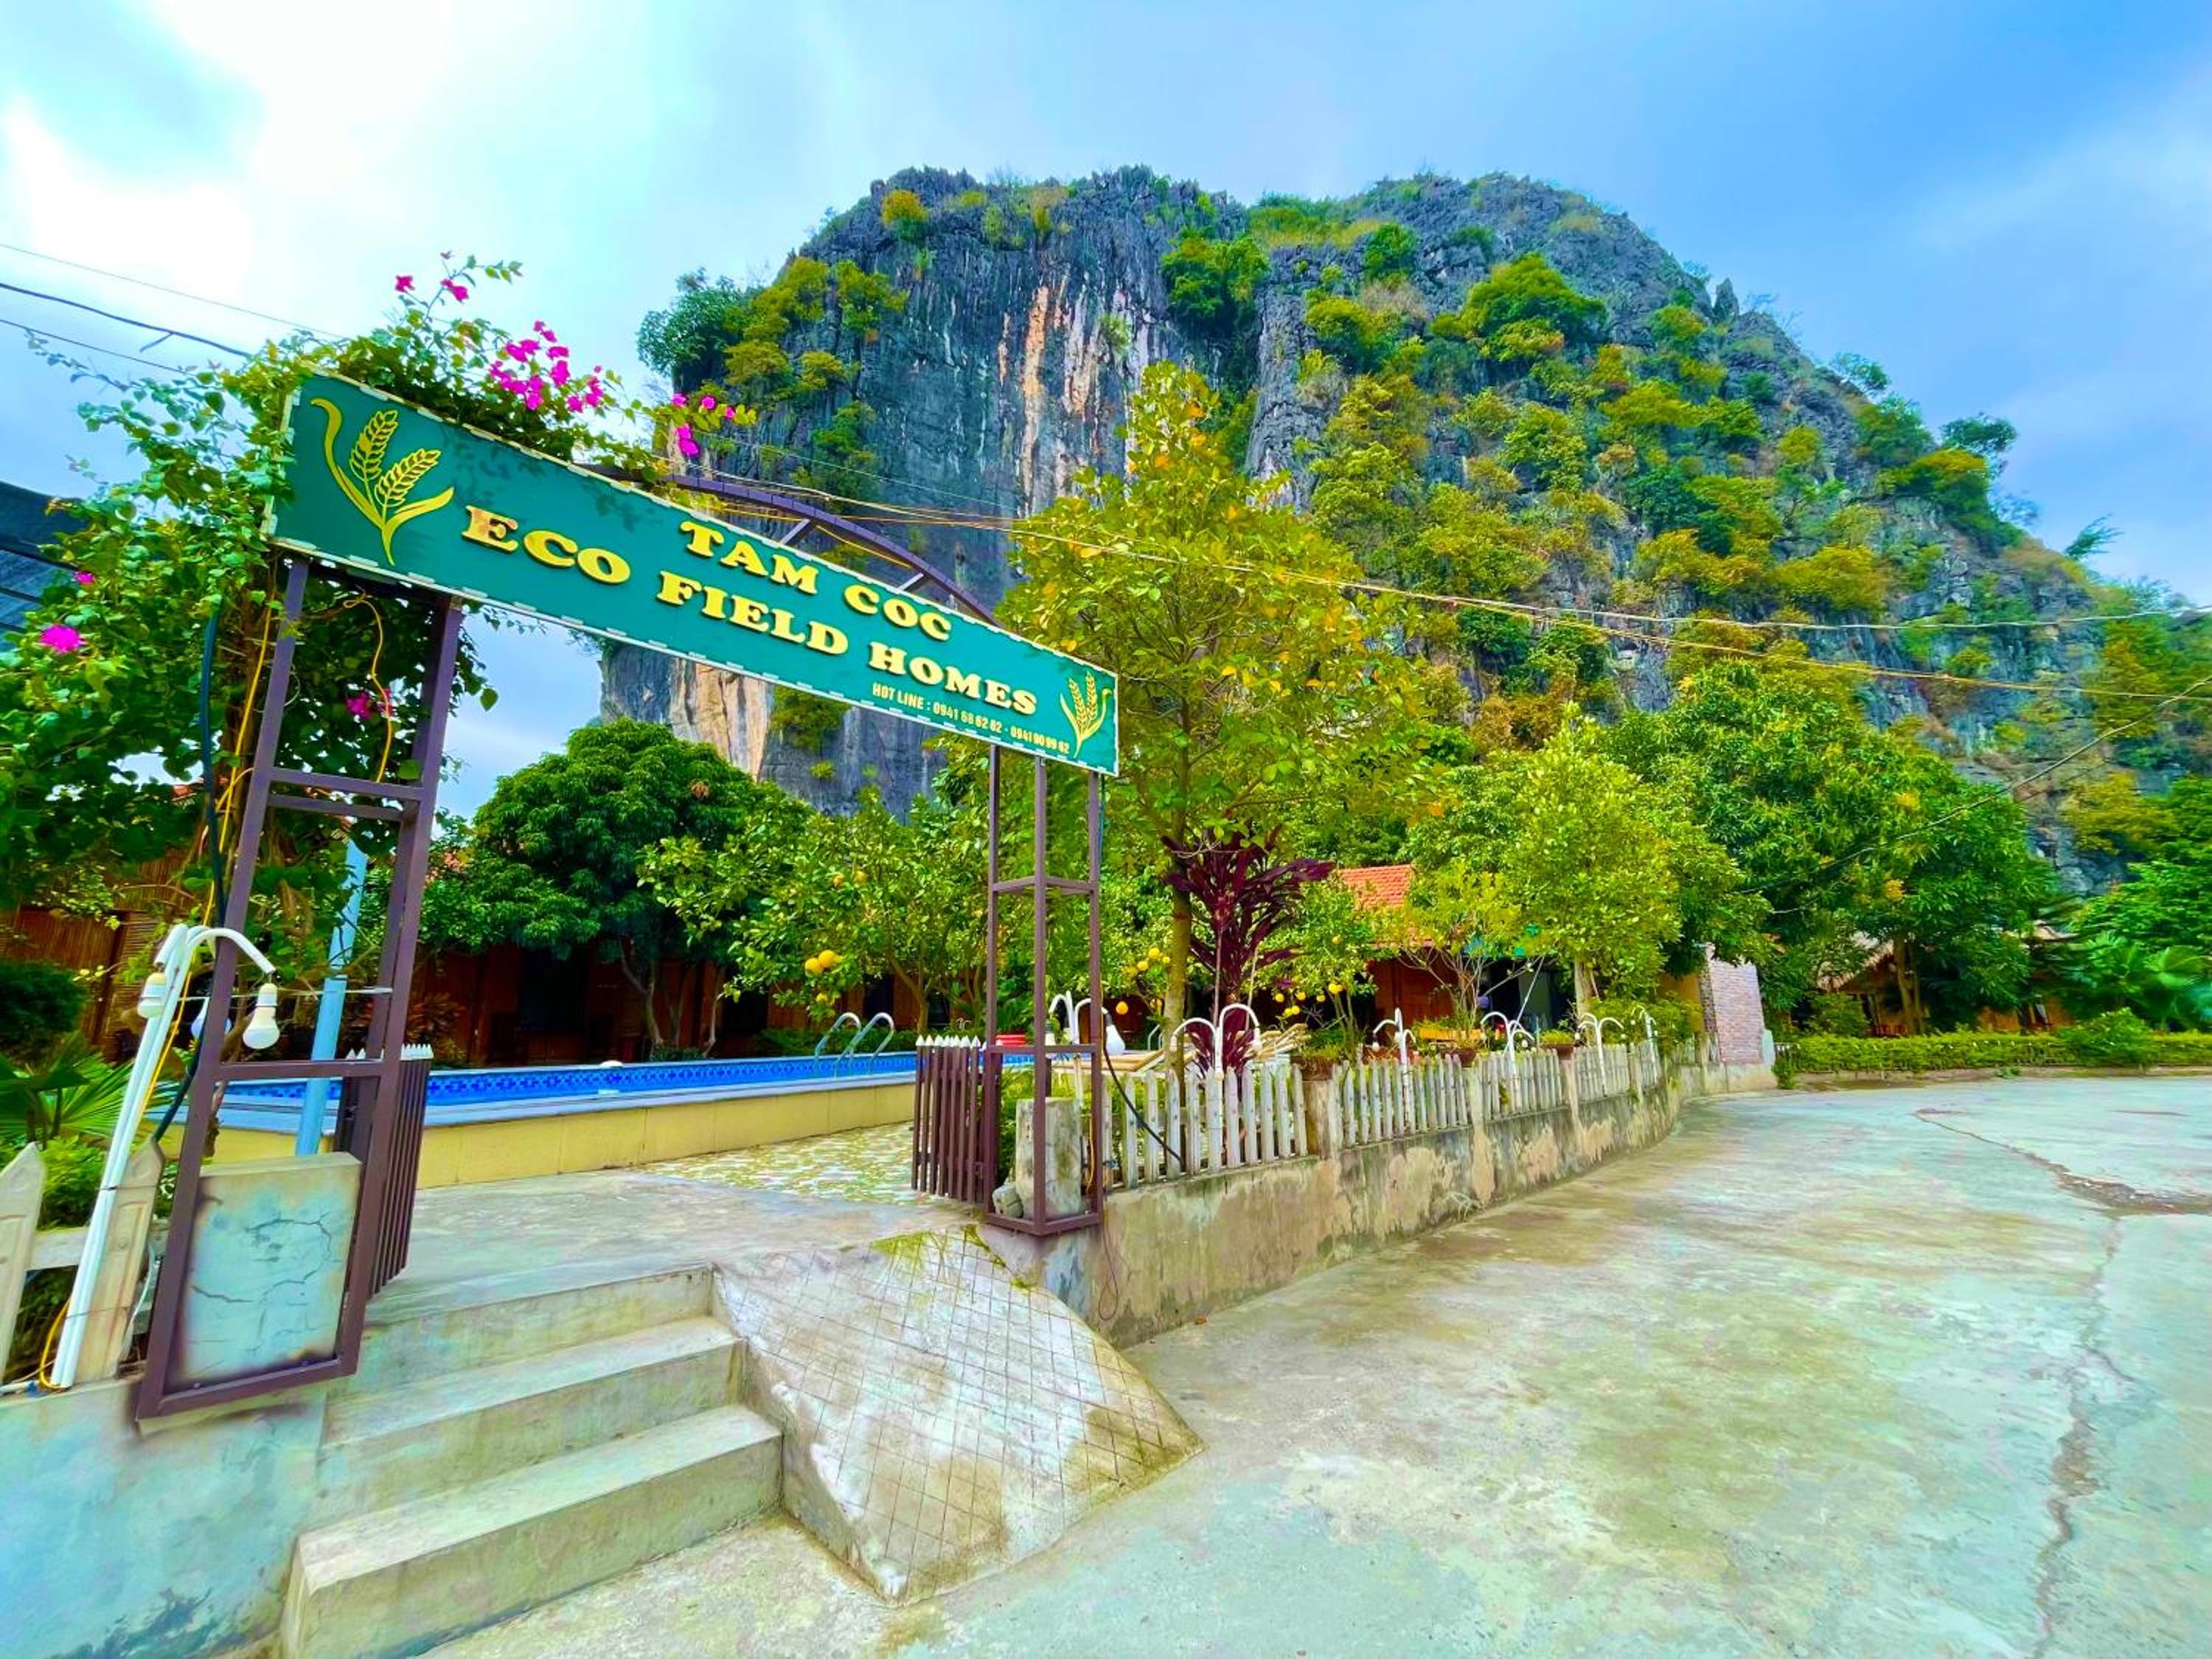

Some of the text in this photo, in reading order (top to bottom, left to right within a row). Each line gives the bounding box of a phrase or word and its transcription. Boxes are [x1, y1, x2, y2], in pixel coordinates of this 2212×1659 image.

[460, 505, 1037, 715] ECO FIELD HOMES
[679, 520, 952, 641] TAM COC
[872, 682, 896, 701] HOT
[897, 690, 924, 710] LINE
[933, 701, 959, 720] 0941
